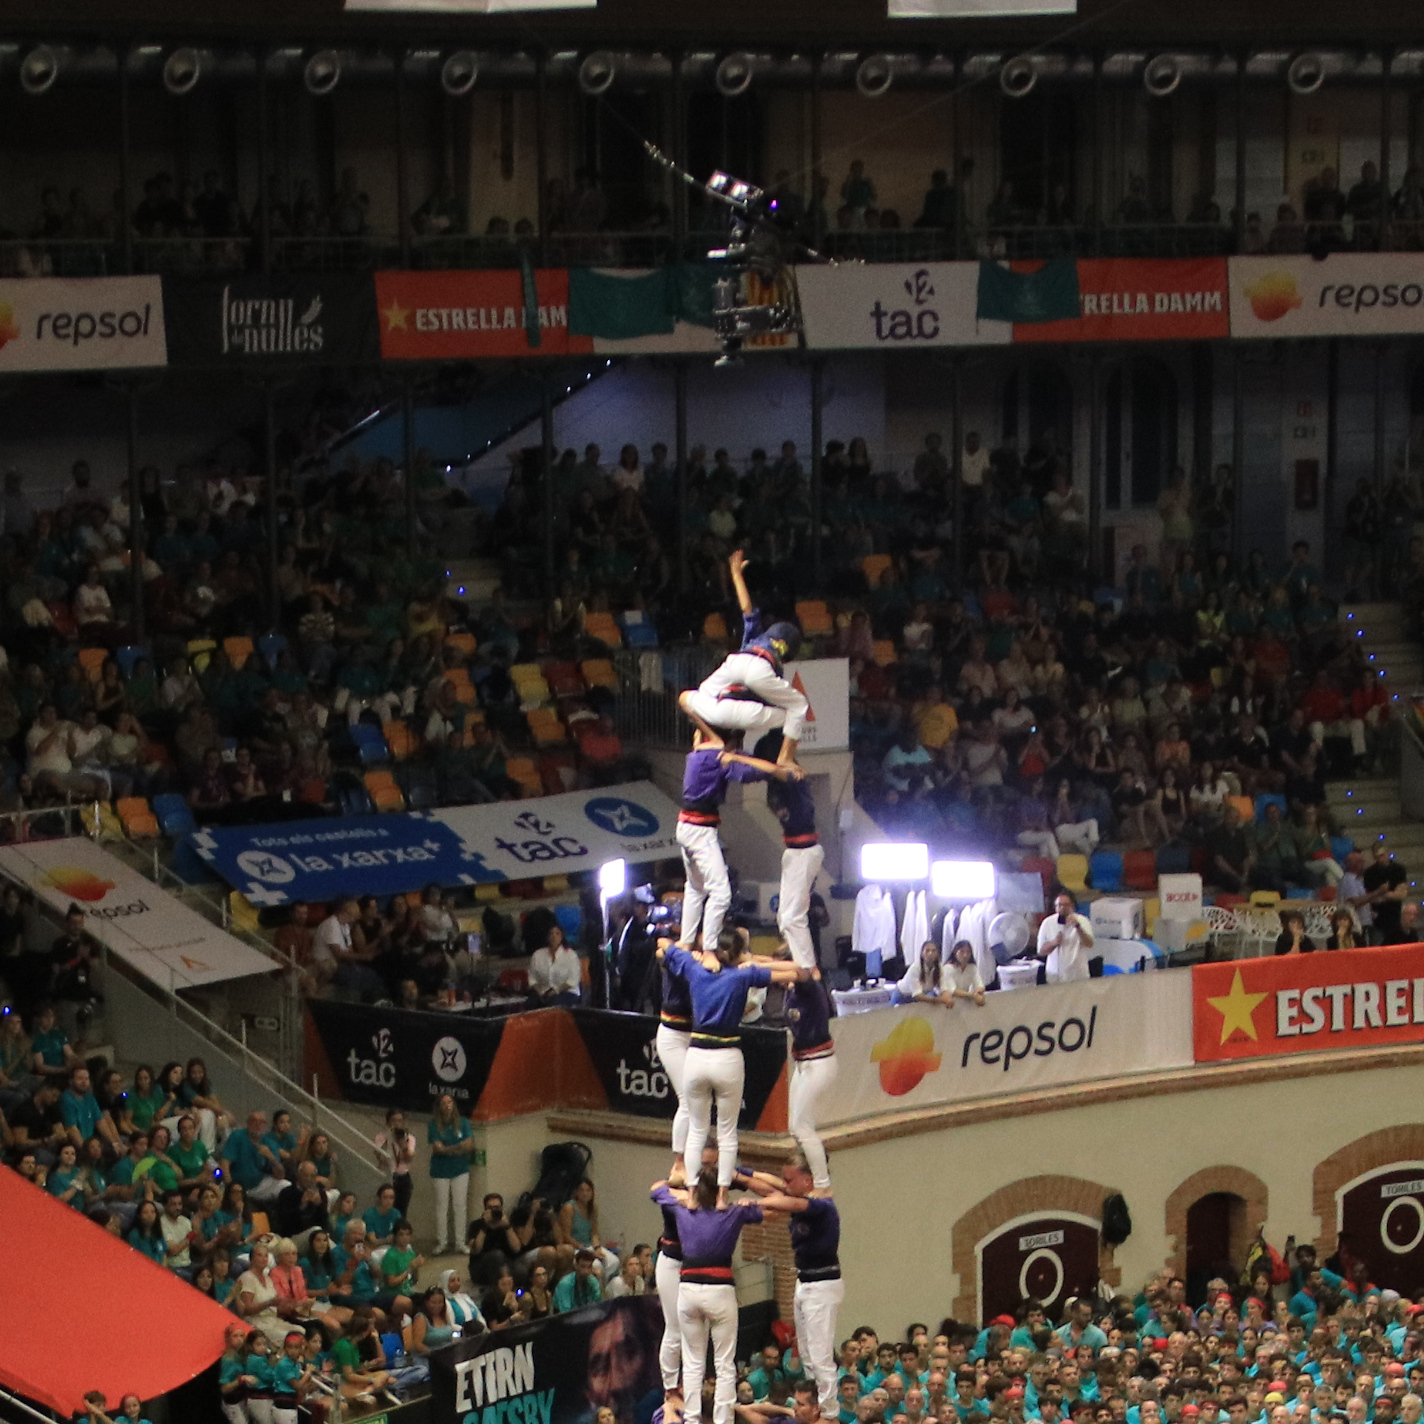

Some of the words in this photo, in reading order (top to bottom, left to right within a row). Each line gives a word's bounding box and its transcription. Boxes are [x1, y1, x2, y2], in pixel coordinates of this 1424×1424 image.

[1154, 291, 1222, 313] DAMM
[36, 302, 151, 347] repsol
[416, 306, 516, 332] ESTRELLA
[871, 301, 939, 340] tac
[289, 852, 333, 873] la
[494, 836, 589, 863] tac
[961, 1005, 1097, 1071] repsol
[347, 1048, 396, 1088] tac
[616, 1059, 669, 1098] tac
[1386, 1181, 1422, 1195] TORILES
[1024, 1234, 1060, 1247] TORILES
